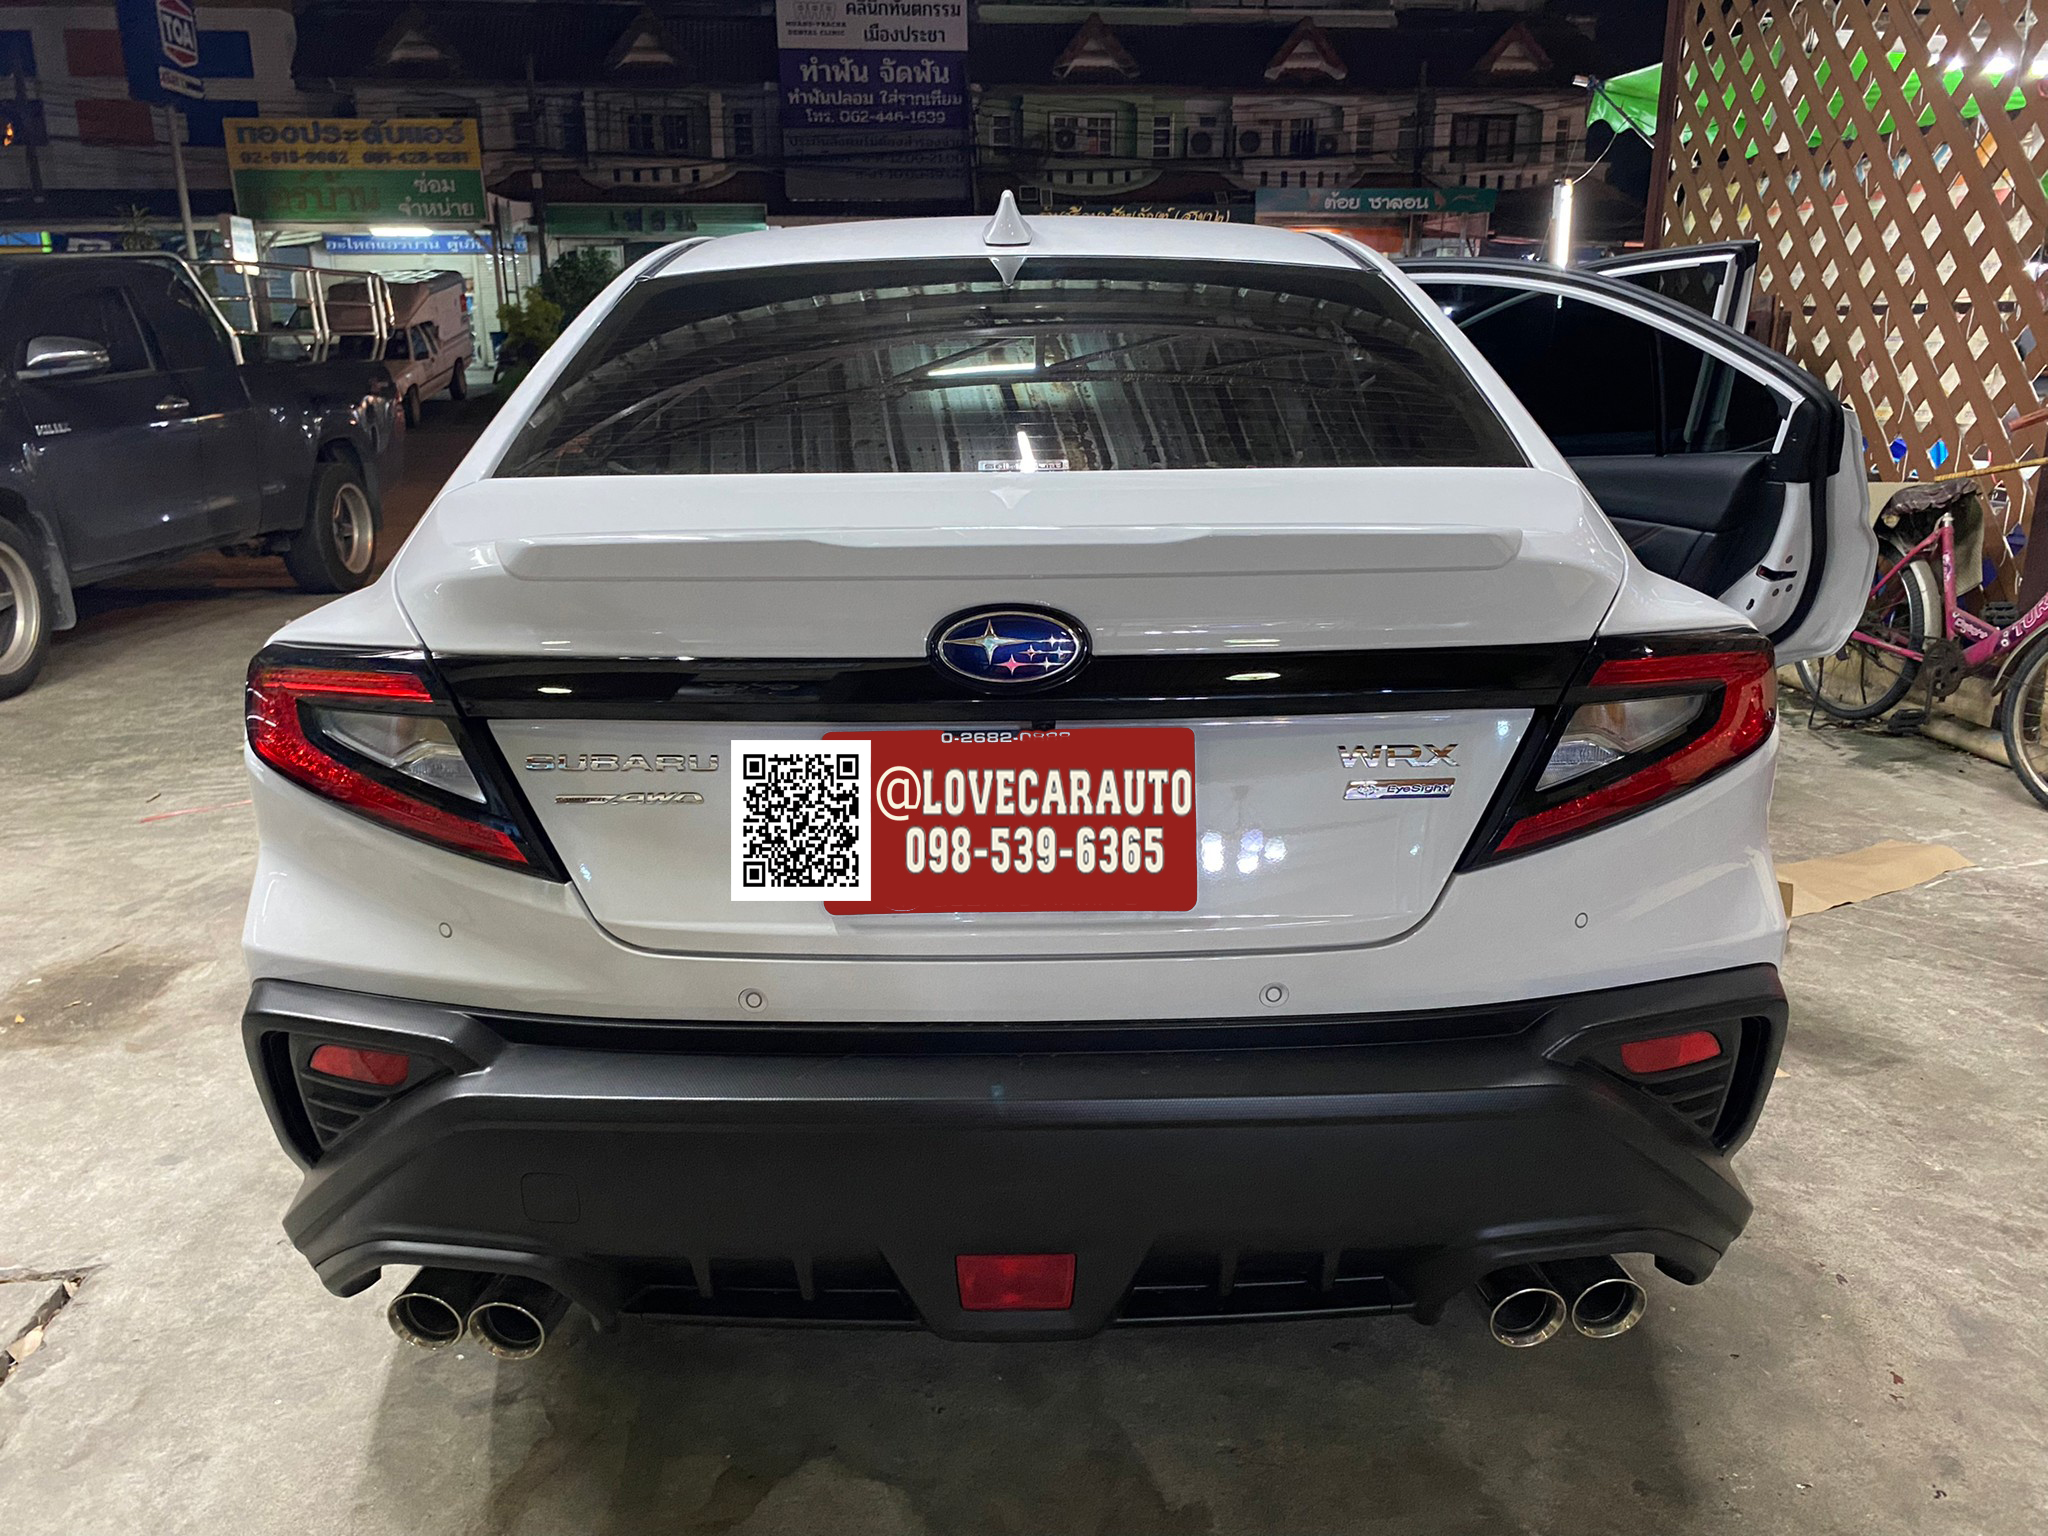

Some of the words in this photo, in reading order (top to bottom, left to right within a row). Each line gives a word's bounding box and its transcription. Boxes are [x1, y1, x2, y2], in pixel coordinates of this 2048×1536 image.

[160, 13, 195, 51] TOA
[864, 24, 945, 43] เมืองประชา
[800, 57, 869, 83] ทำฟัน
[879, 57, 950, 84] จัดฟัน
[787, 88, 874, 105] ทำฟันปลอม
[879, 89, 963, 106] ใส่รากเทียม
[805, 109, 835, 123] โทร.
[413, 172, 456, 193] ซ่อม
[398, 196, 475, 217] จำหน่าย
[1324, 192, 1360, 210] ต้อย
[525, 754, 719, 771] SUBARU
[1337, 744, 1459, 768] WRX
[616, 791, 704, 805] AWD
[1387, 784, 1448, 794] EyeSight
